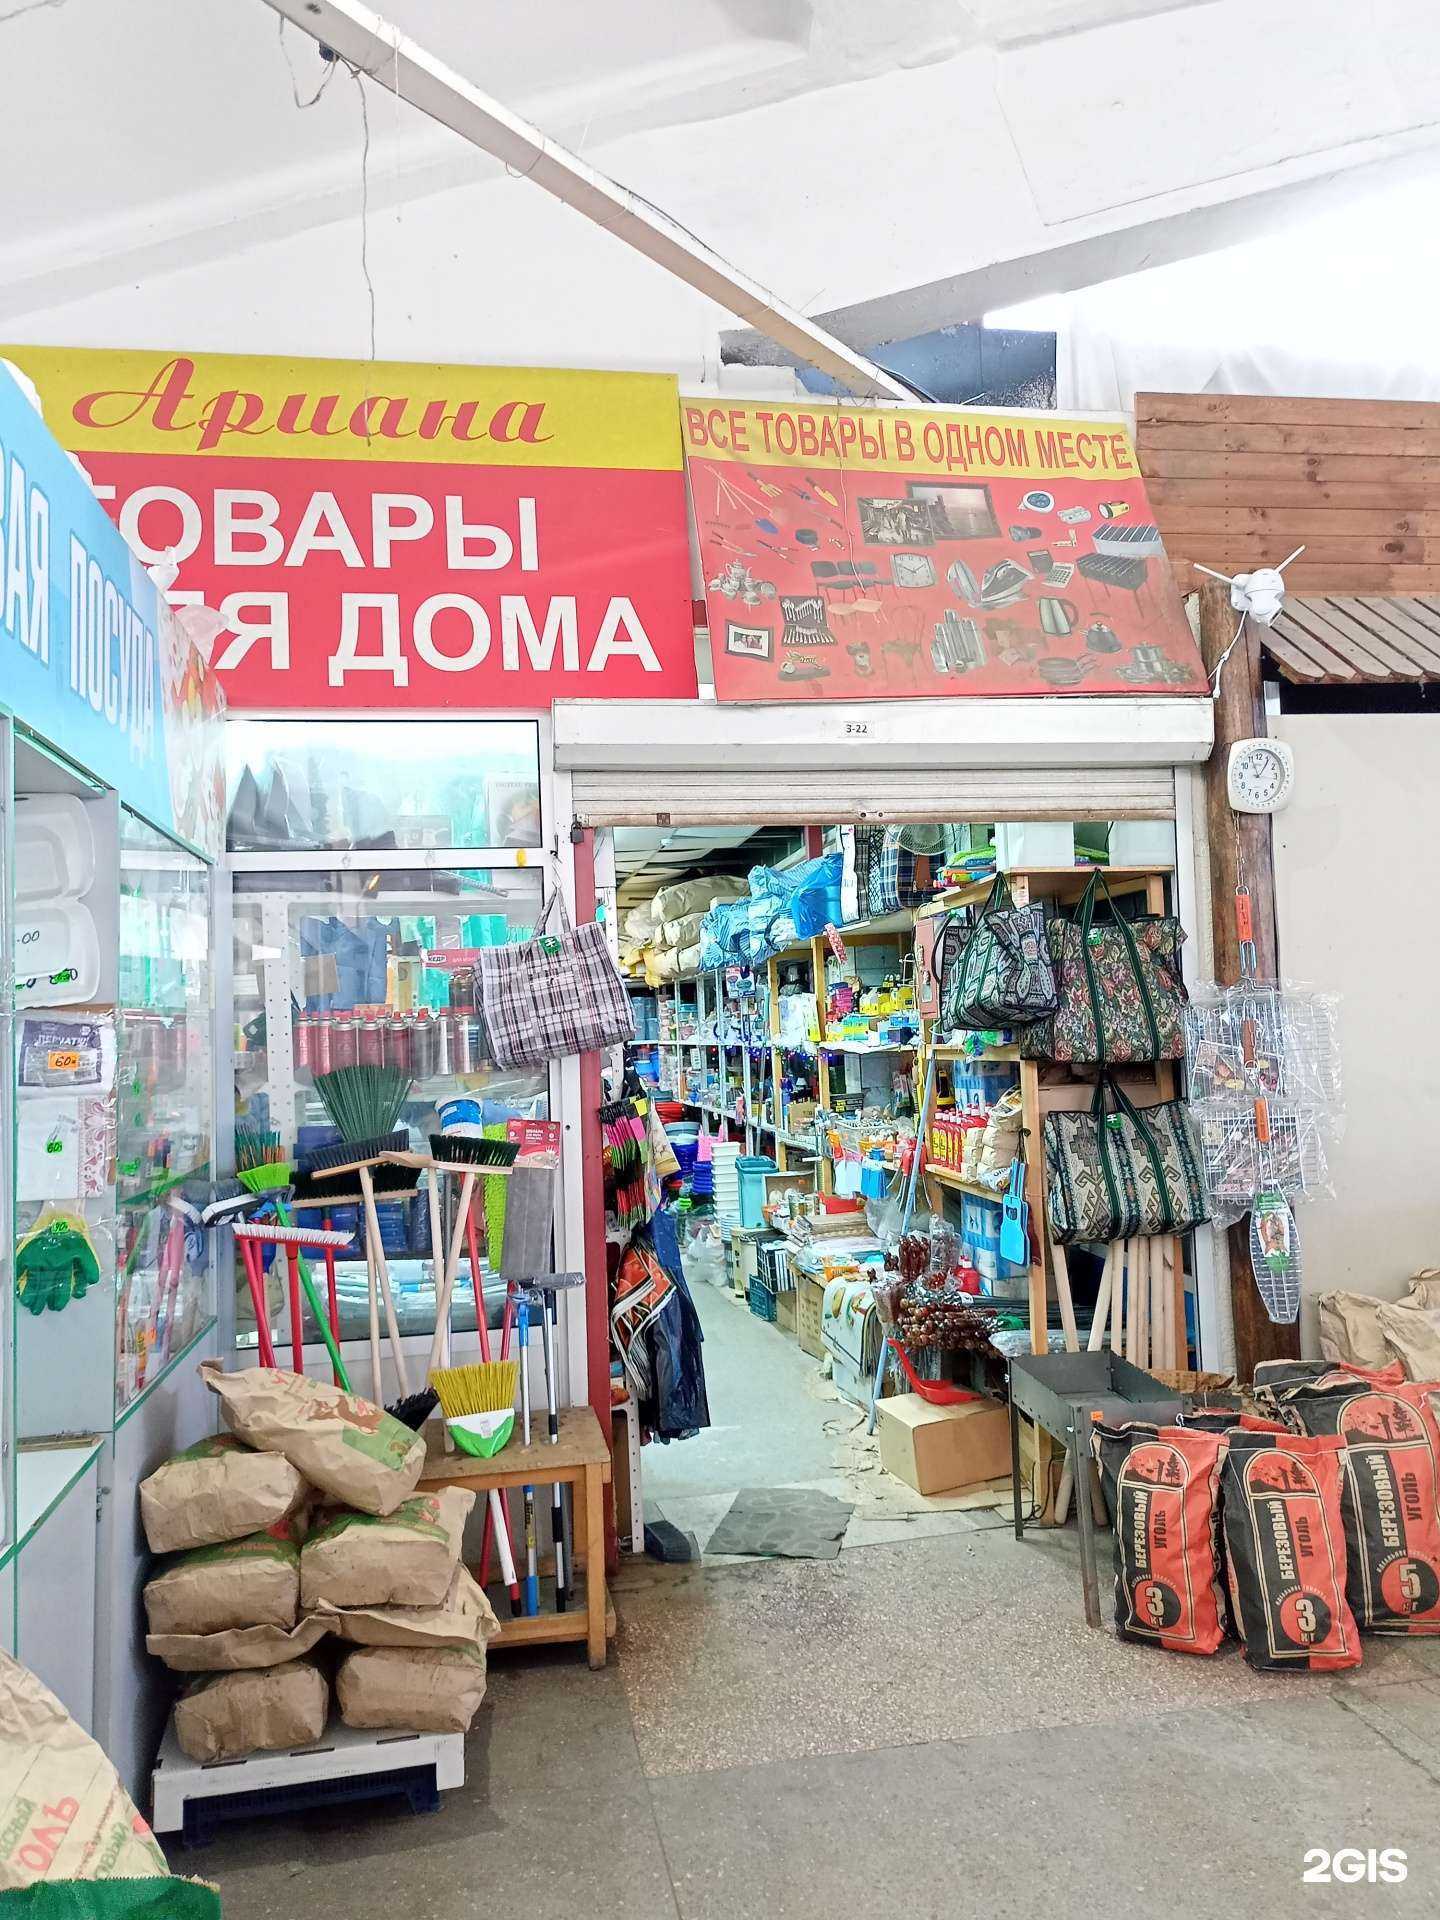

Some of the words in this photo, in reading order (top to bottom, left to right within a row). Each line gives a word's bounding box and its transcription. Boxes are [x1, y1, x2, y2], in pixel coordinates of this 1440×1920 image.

[72, 358, 555, 451] Ариана
[685, 406, 751, 453] ВСЕ
[755, 412, 887, 461] ТОВАРЫ
[894, 421, 915, 462] В
[923, 421, 1029, 472] ОДНОМ
[1034, 430, 1134, 471] МЕСТЕ
[70, 531, 155, 767] ПОСУДА
[328, 592, 663, 687] ДОМА
[1132, 1490, 1149, 1569] БЕРЕЗОВЫЙ
[1153, 1510, 1167, 1549] УГОЛЬ
[1365, 1454, 1400, 1548] БЕРЕЗОВЫЙ
[1401, 1472, 1423, 1521] УГОЛЬ
[1266, 1500, 1297, 1580] БЕРЕЗОВЫЙ
[1295, 1516, 1314, 1557] УГОЛЬ
[1145, 1587, 1164, 1616] 3
[1399, 1563, 1421, 1599] 5
[1295, 1598, 1317, 1632] 3
